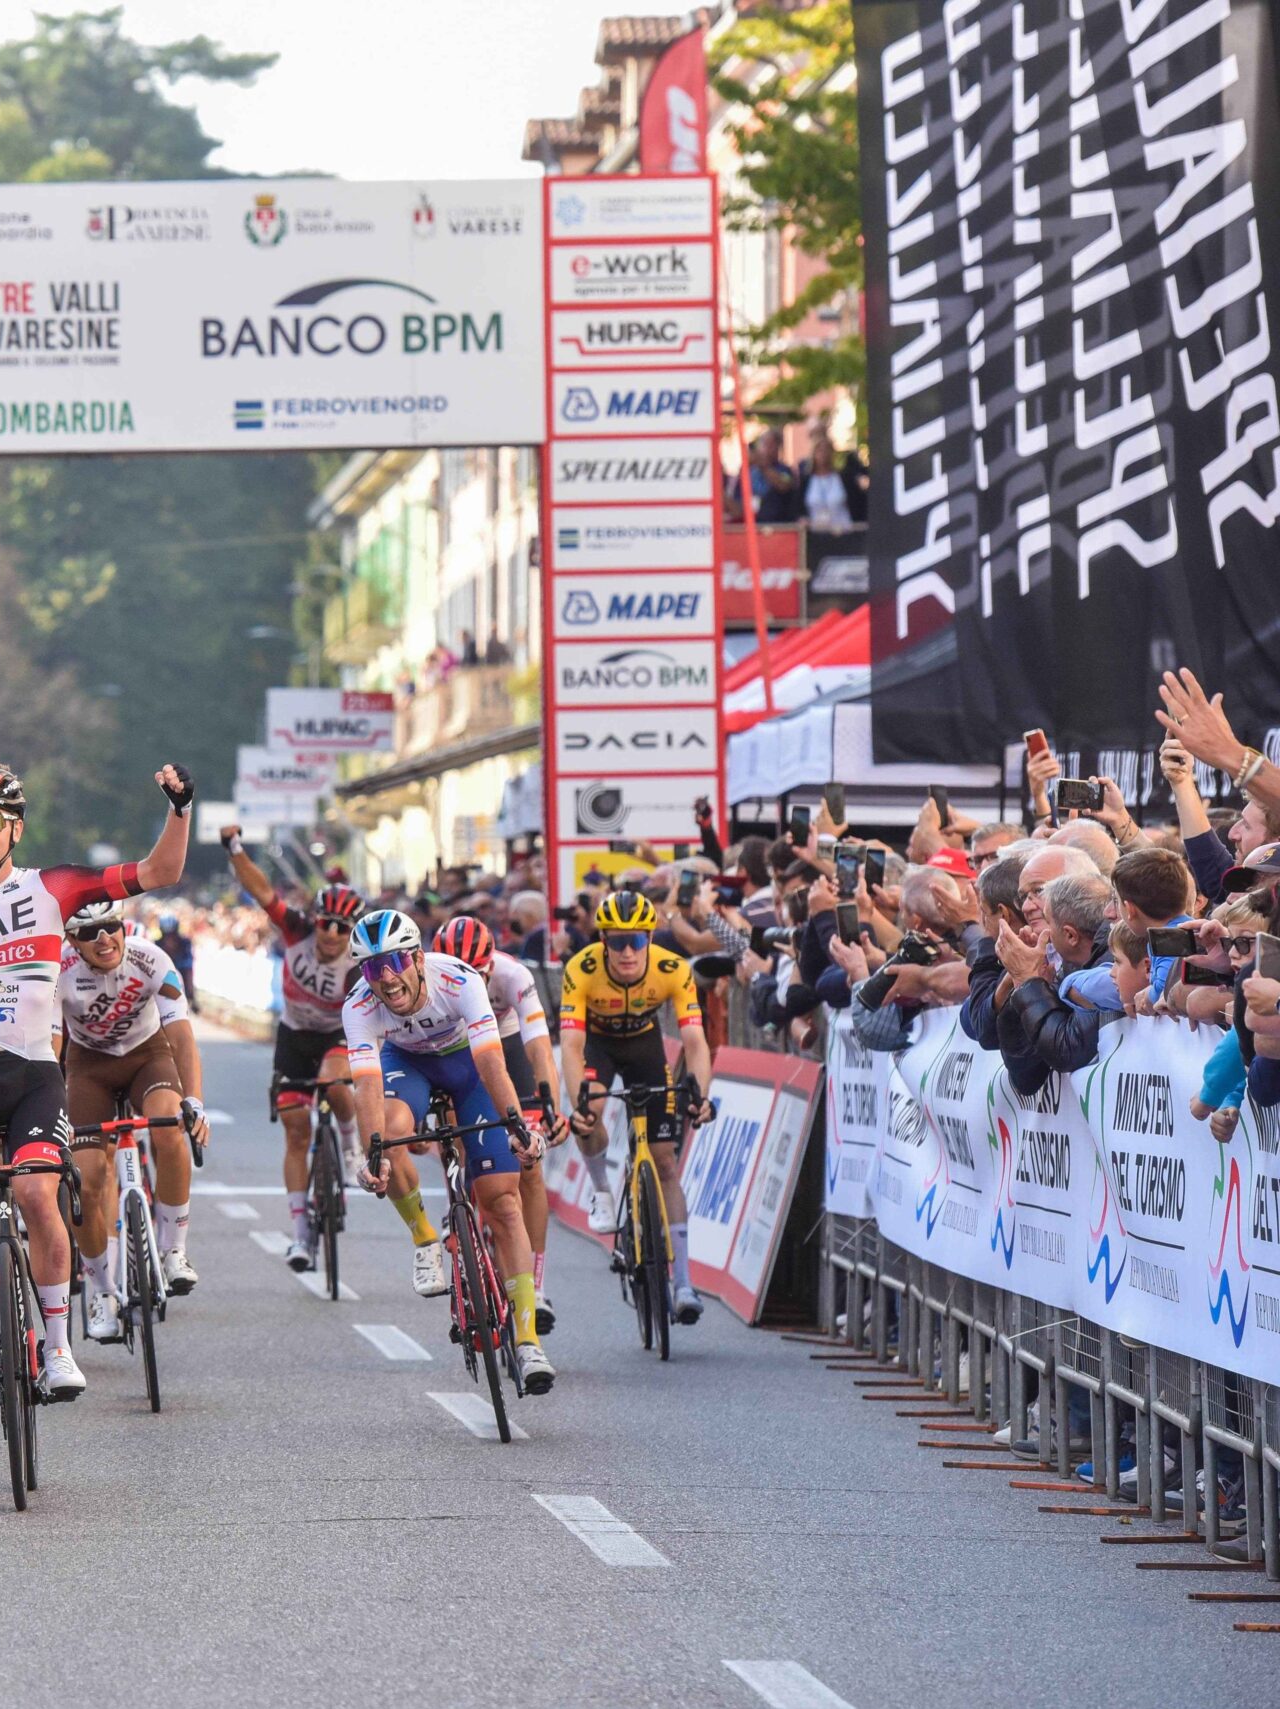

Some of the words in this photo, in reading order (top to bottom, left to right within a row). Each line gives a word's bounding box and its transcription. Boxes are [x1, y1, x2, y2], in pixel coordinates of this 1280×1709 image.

[448, 218, 523, 235] VARESE
[570, 246, 688, 277] e-work
[49, 281, 120, 313] VALLI
[201, 314, 387, 358] BANCO
[401, 312, 503, 354] BPM
[586, 321, 680, 345] HUPAC
[273, 395, 449, 415] FERROVIENORD
[606, 390, 701, 417] MAPEI
[558, 456, 708, 483] SPECIALIZED
[607, 592, 701, 620] MAPEI
[562, 666, 652, 688] BANCO
[658, 665, 708, 686] BPM
[294, 718, 371, 738] HUPAC
[564, 732, 707, 751] DACIA
[1113, 1072, 1174, 1138] MINISTERO
[1029, 1131, 1071, 1192] TURISMO
[1111, 1150, 1133, 1212] DEL
[1135, 1153, 1186, 1222] TURISMO
[1253, 1173, 1273, 1242] DEL
